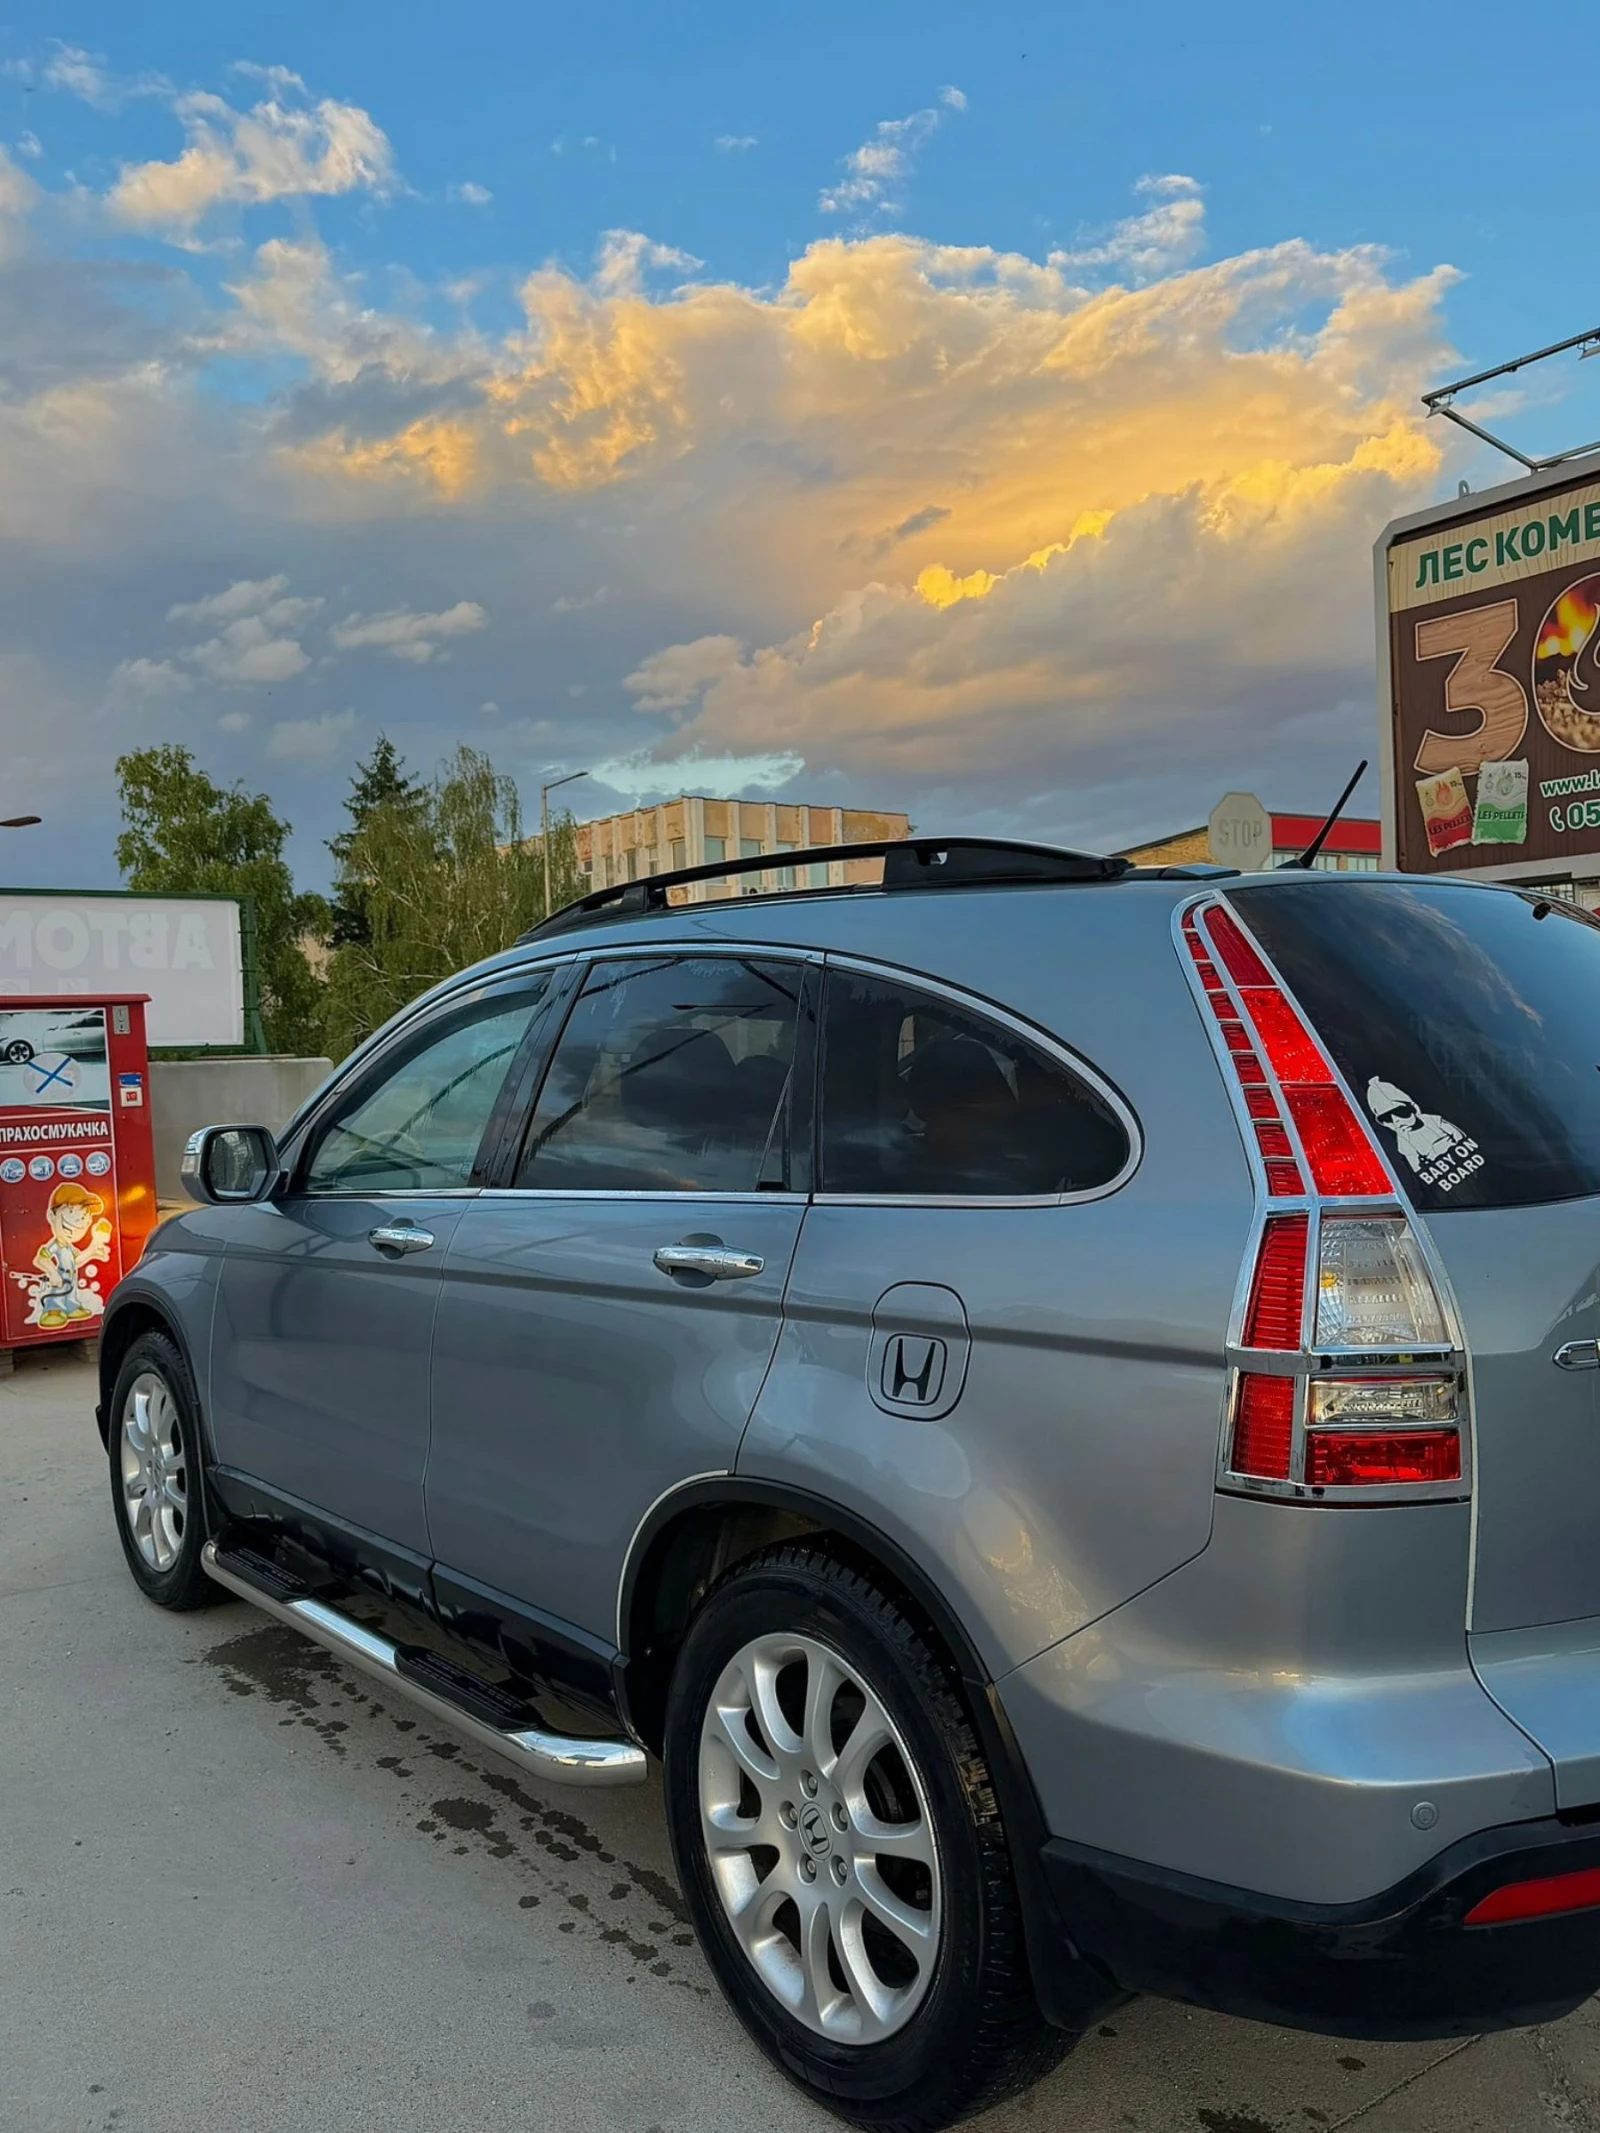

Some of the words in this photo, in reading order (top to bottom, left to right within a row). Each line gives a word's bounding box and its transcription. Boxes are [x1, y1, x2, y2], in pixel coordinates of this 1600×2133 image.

[1416, 538, 1489, 589] ЛЕС
[1496, 502, 1600, 566] КОМЕ
[1540, 769, 1600, 797] www.l
[1219, 819, 1262, 848] STOP
[0, 1121, 108, 1143] ПРАХОСМУКАЧКА
[1419, 1153, 1457, 1185] BABY
[1455, 1138, 1479, 1158] ON
[1438, 1154, 1485, 1191] BOARD
